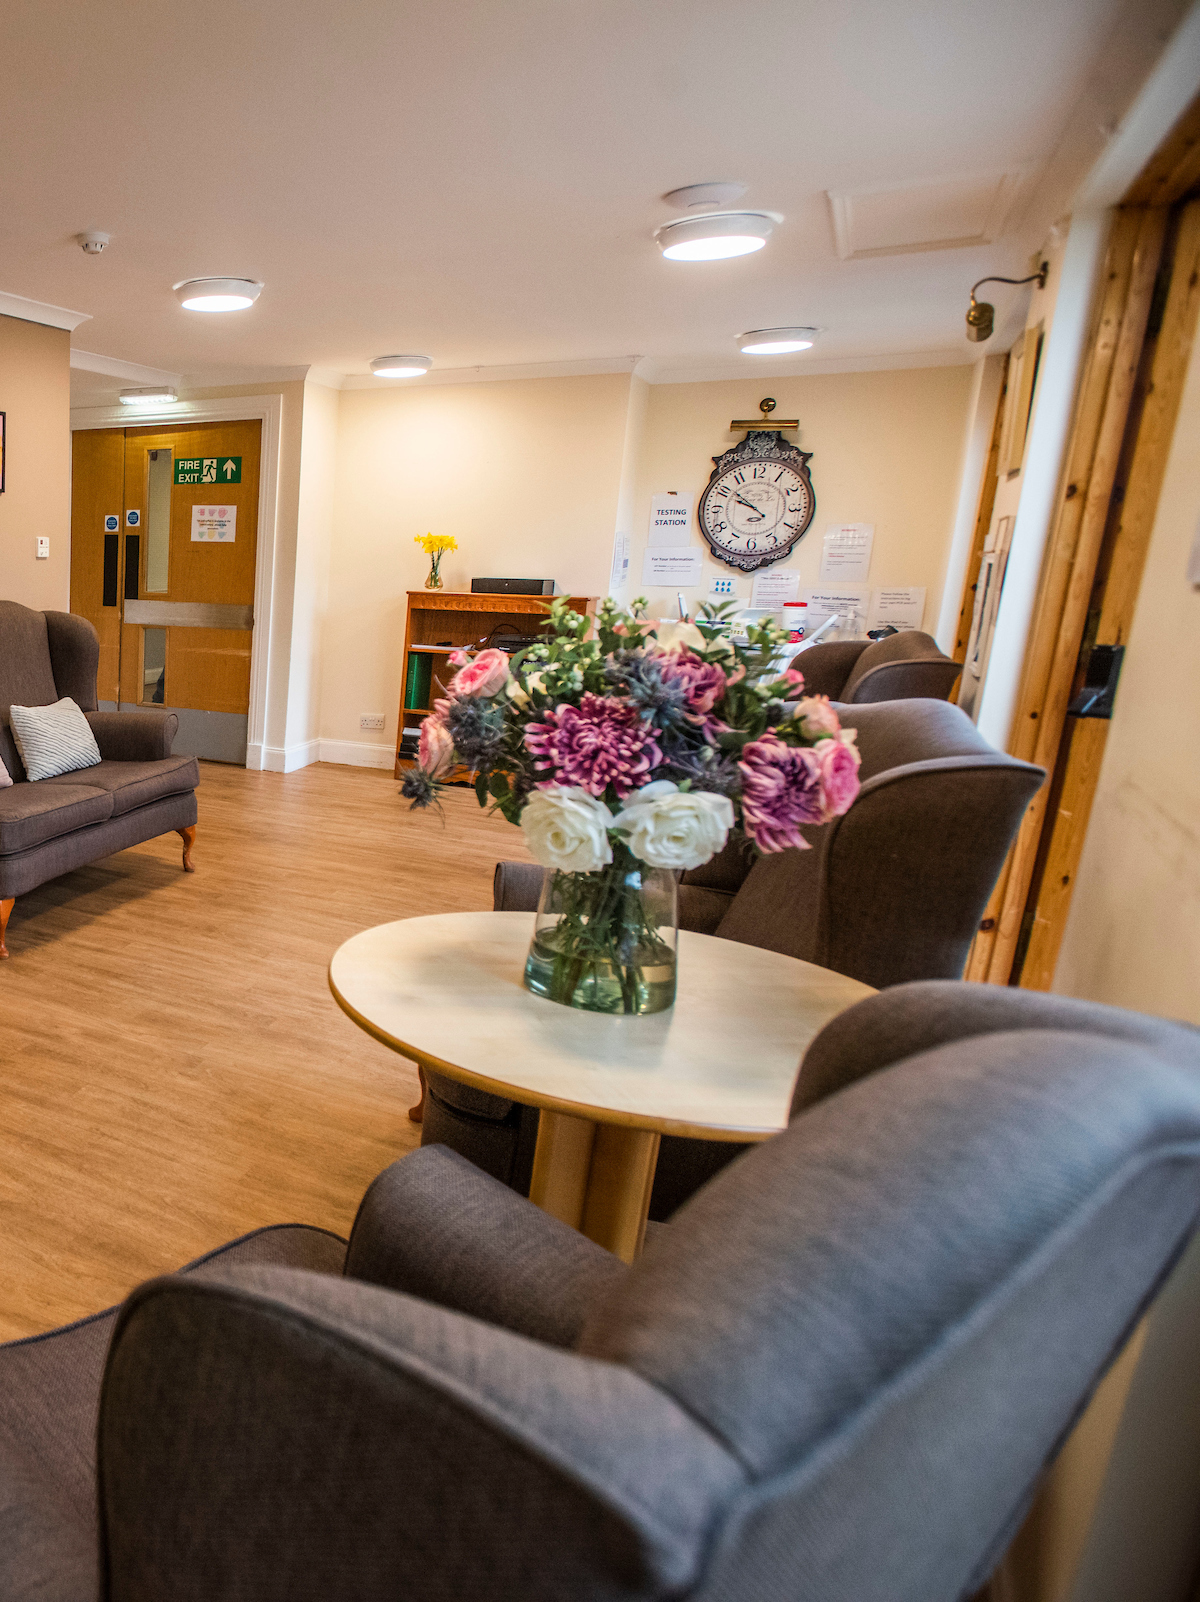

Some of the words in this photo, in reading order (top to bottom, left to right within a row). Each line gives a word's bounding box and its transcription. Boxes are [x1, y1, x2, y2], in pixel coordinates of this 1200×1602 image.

[179, 460, 200, 470] FIRE
[178, 473, 199, 482] EXIT
[733, 471, 746, 485] 11
[753, 466, 767, 479] 12
[774, 471, 784, 483] 1
[717, 485, 732, 498] 10
[784, 483, 799, 497] 2
[710, 505, 725, 514] 9
[788, 503, 803, 513] 3
[713, 521, 728, 534] 8
[726, 532, 741, 545] 7
[746, 538, 757, 551] 6
[765, 532, 779, 546] 5
